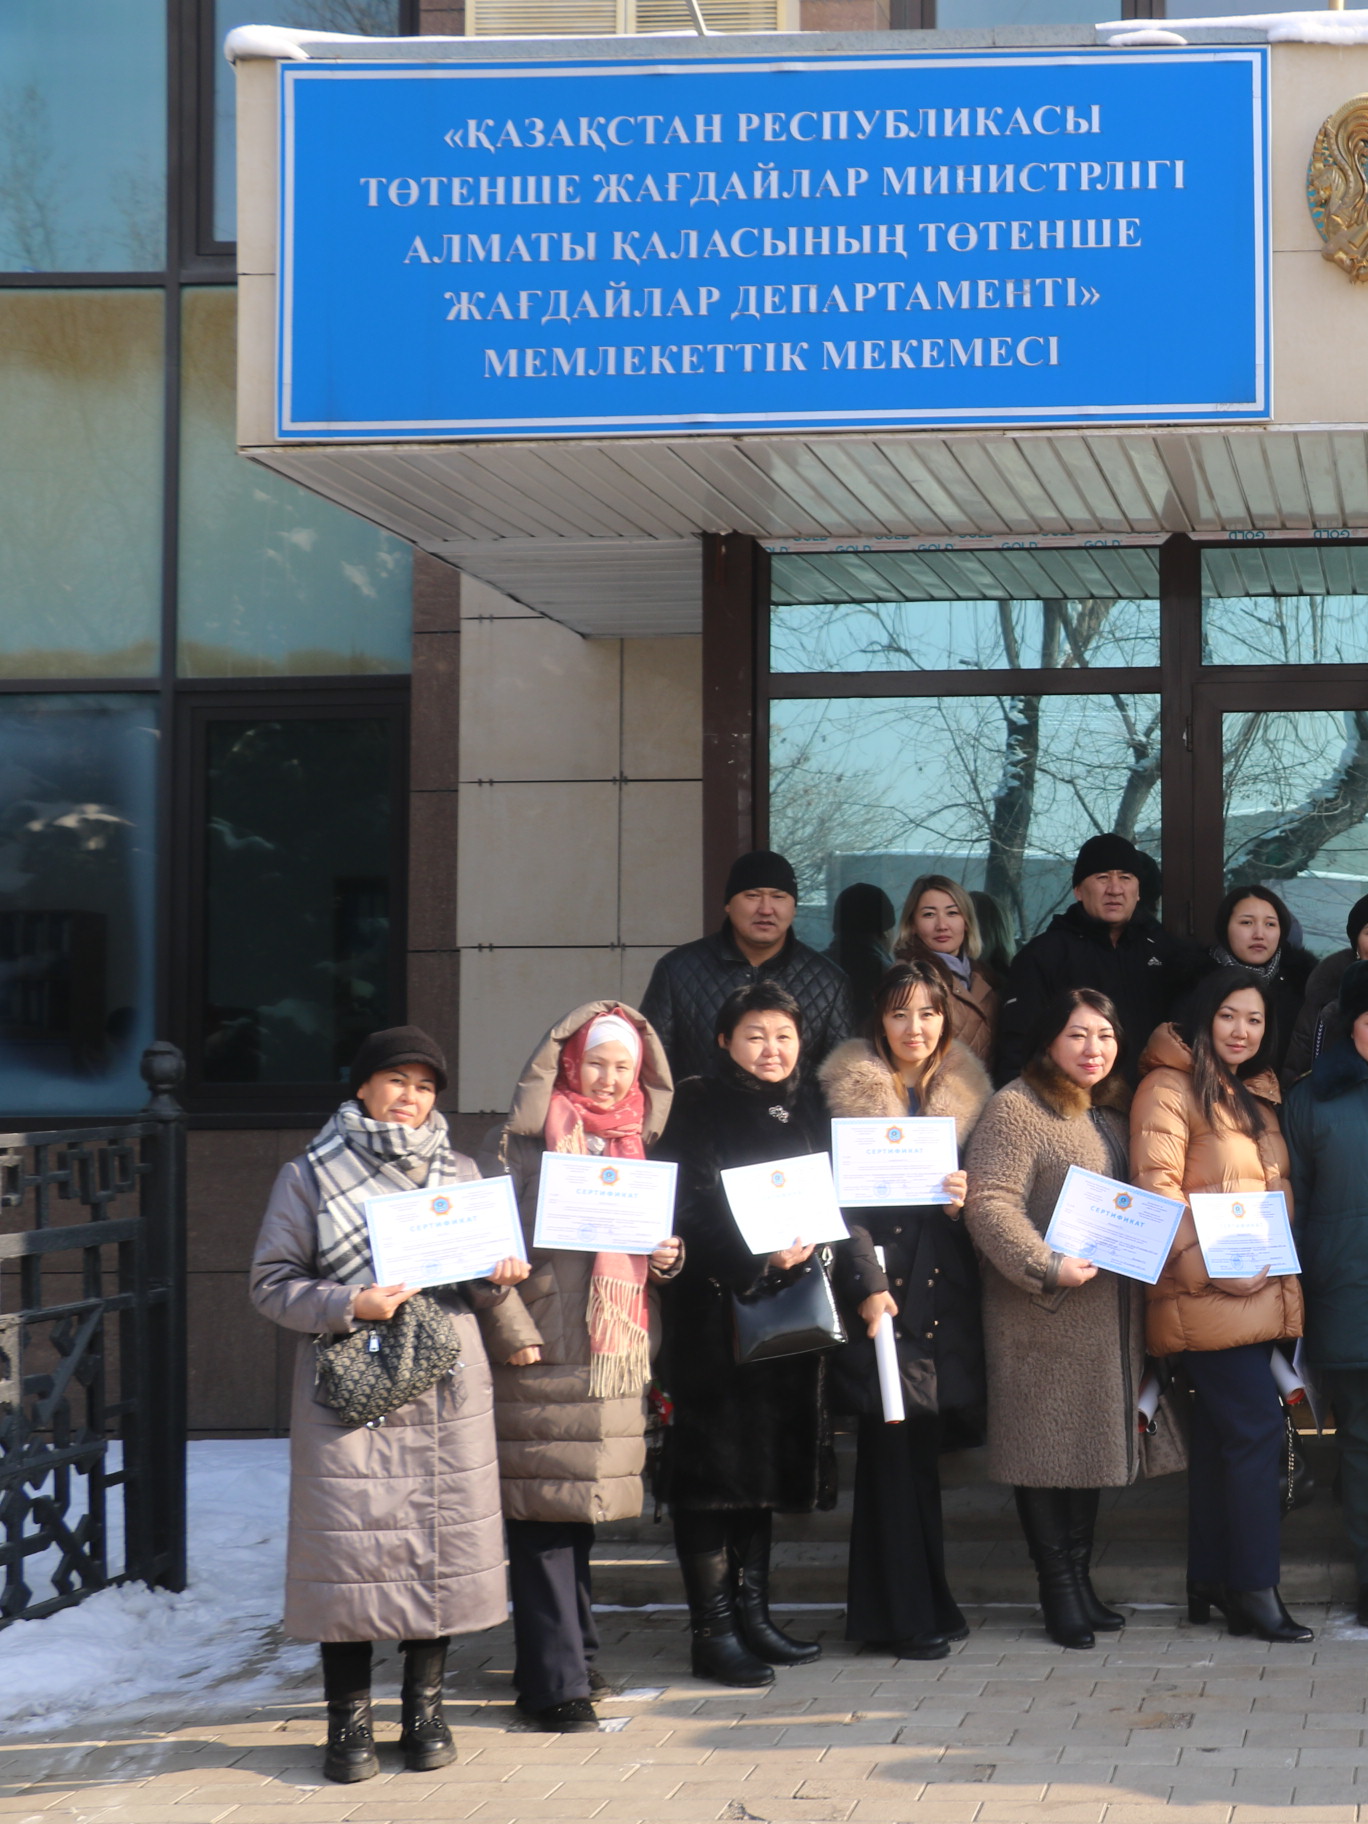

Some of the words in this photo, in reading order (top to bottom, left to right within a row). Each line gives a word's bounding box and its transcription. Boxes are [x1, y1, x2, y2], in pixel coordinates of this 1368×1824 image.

[444, 113, 722, 153] «ҚАЗАҚСТАН
[738, 104, 1101, 142] РЕСПУБЛИКАСЫ
[360, 174, 581, 207] ТӨТЕНШЕ
[593, 162, 869, 206] ЖАҒДАЙЛАР
[882, 159, 1185, 196] МИНИСТРЛІГІ
[404, 231, 596, 264] АЛМАТЫ
[612, 224, 908, 265] ҚАЛАСЫНЫҢ
[918, 217, 1142, 252] ТӨТЕНШЕ
[444, 280, 721, 324] ЖАҒДАЙЛАР
[730, 277, 1101, 320] ДЕПАРТАМЕНТІ»
[484, 341, 809, 378] МЕМЛЕКЕТТІК
[822, 336, 1058, 370] МЕКЕМЕСІ
[1228, 530, 1265, 540] GOLD
[1313, 529, 1350, 539] GOLD
[1090, 1205, 1145, 1228] СЕРТИФИКАТ
